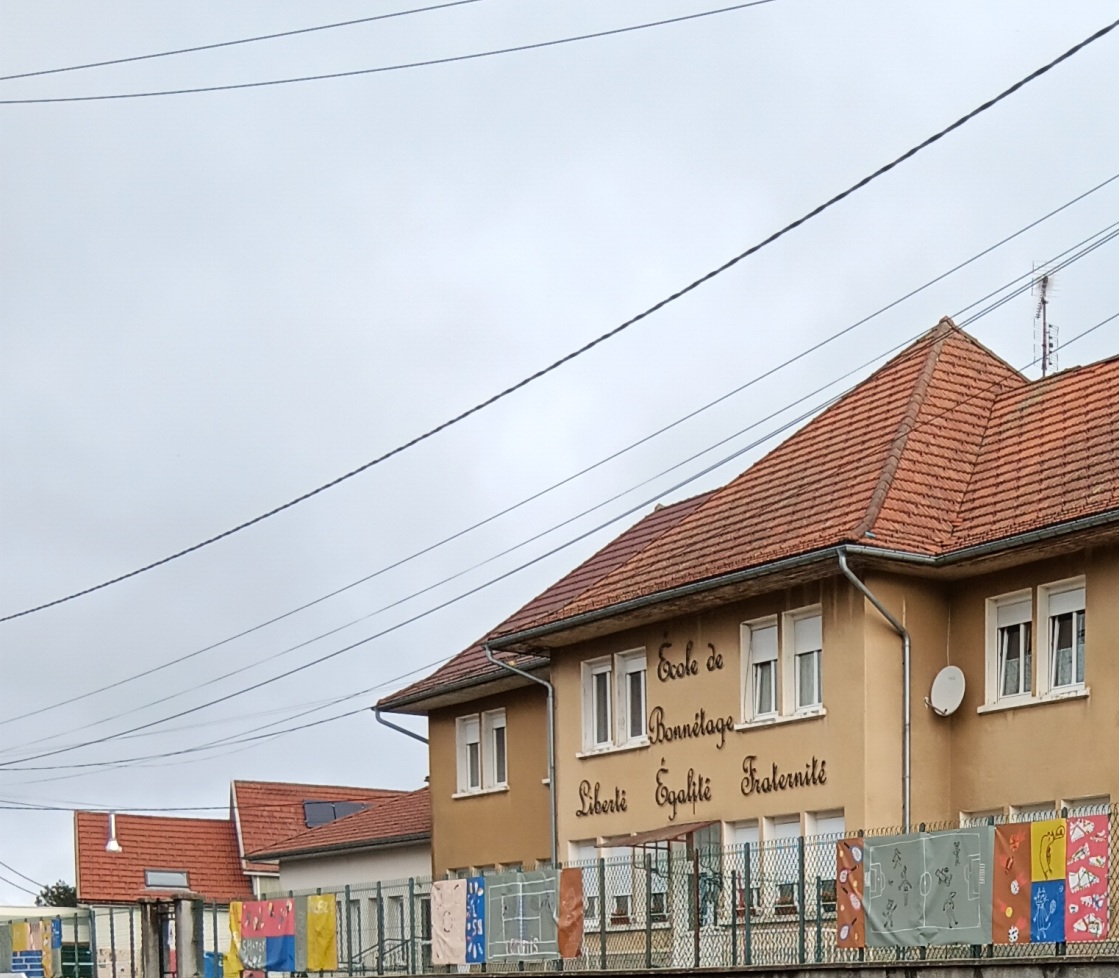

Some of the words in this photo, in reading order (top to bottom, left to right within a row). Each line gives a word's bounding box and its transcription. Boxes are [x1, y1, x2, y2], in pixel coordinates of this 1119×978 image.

[657, 632, 698, 683] École
[706, 642, 724, 672] de
[648, 706, 735, 750] Bonnétage
[576, 779, 627, 817] Liberté
[655, 757, 712, 821] Égalité
[741, 755, 827, 797] Fraternité
